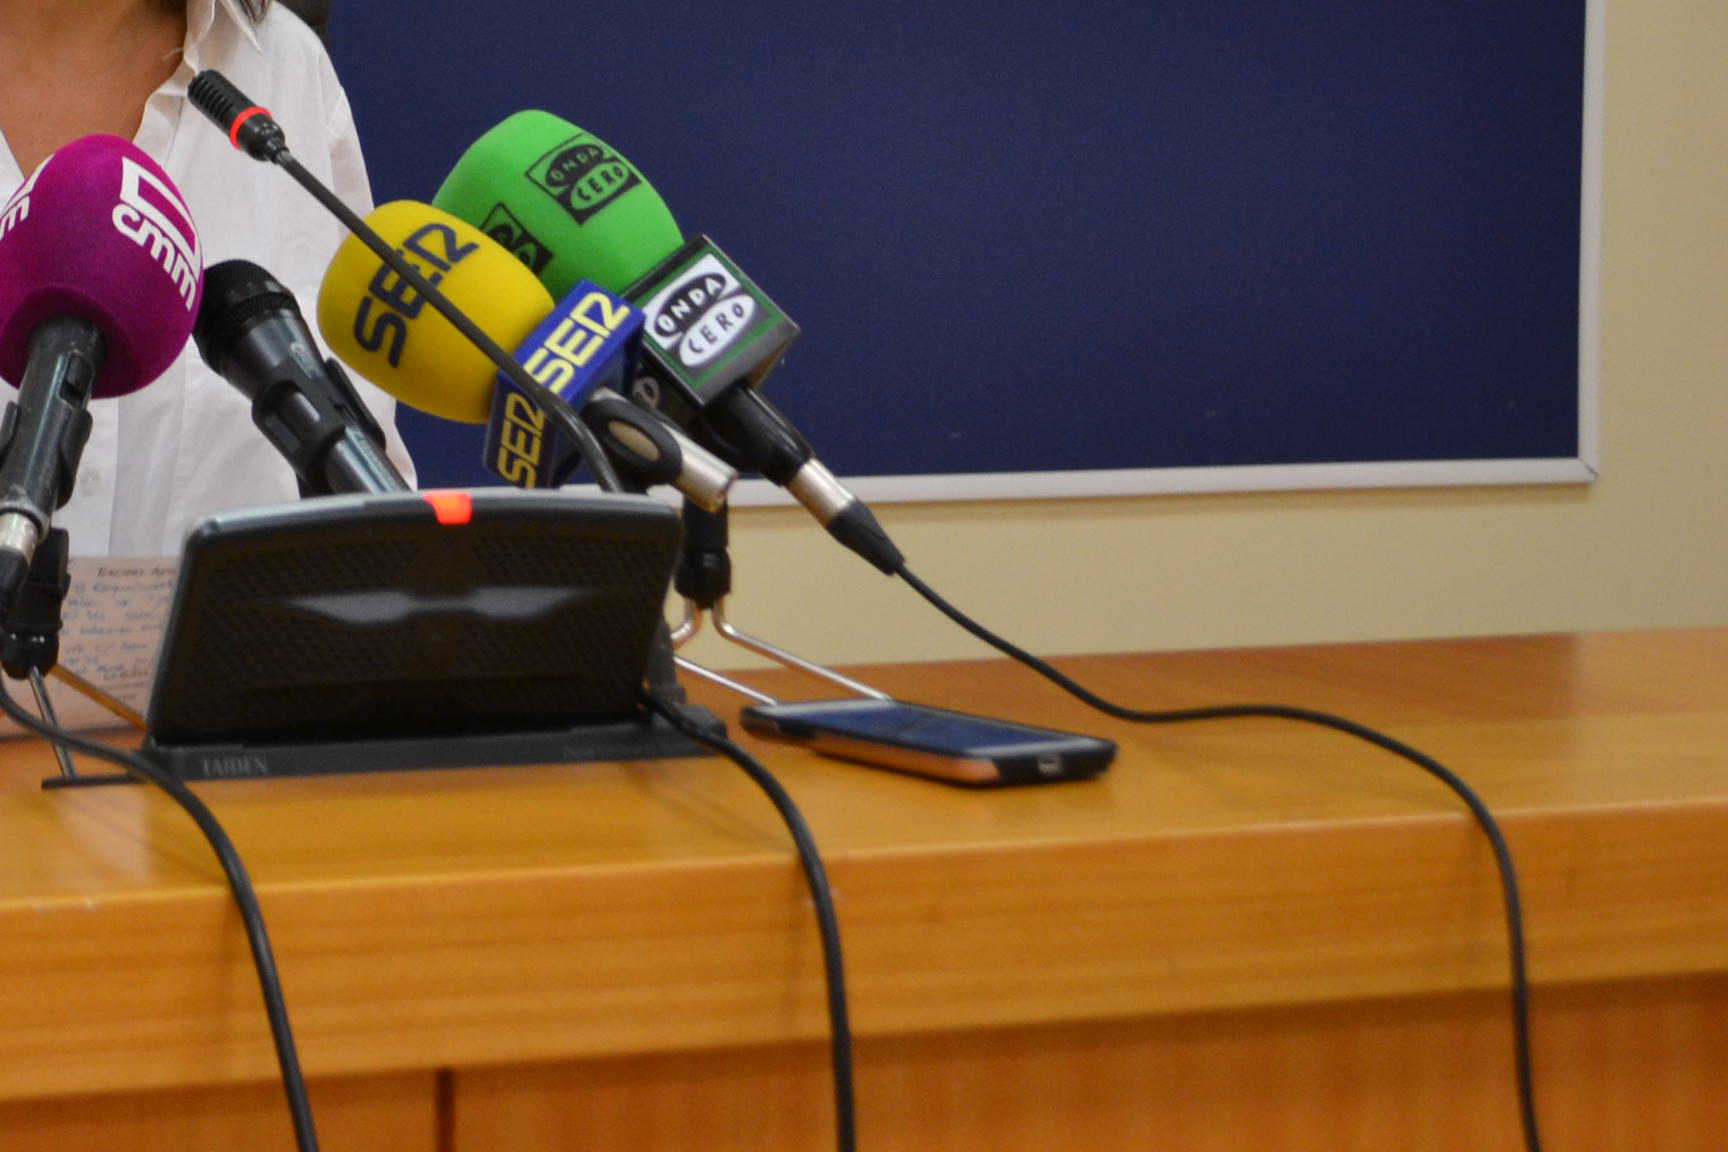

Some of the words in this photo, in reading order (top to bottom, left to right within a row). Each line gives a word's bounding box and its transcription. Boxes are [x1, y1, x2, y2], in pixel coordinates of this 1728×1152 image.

[656, 275, 724, 334] ONDA
[687, 301, 748, 355] CERO
[523, 291, 631, 395] SER
